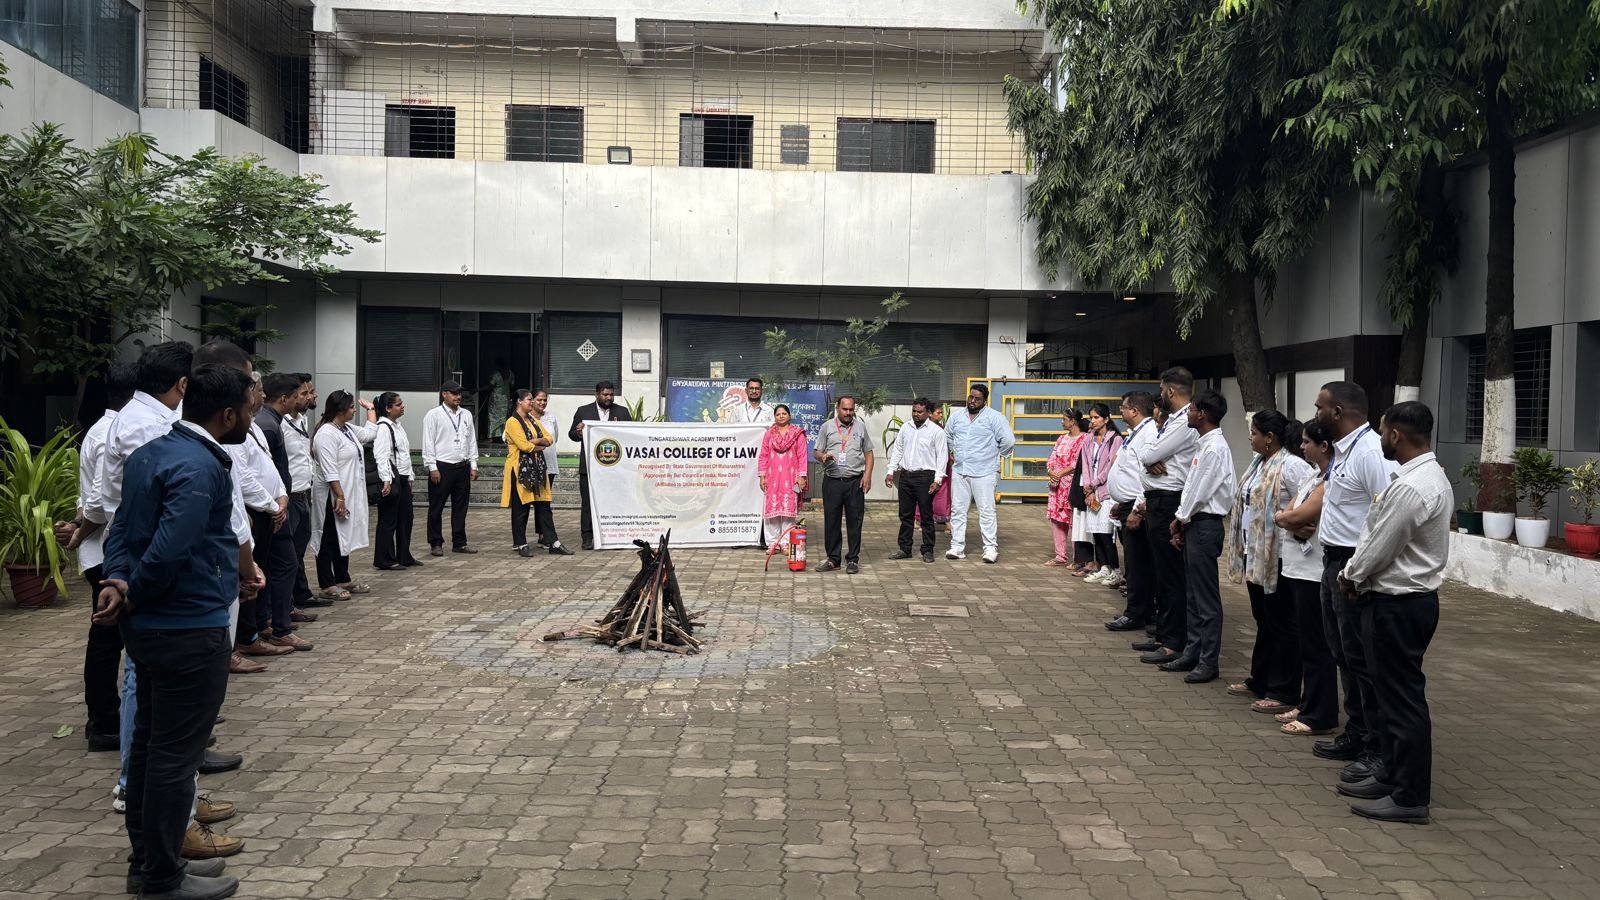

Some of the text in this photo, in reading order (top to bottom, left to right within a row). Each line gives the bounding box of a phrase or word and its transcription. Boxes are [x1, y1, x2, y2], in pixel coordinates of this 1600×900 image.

[625, 446, 758, 459] VASAI COLLEGE OF LAW
[718, 526, 757, 534] 8855815879
